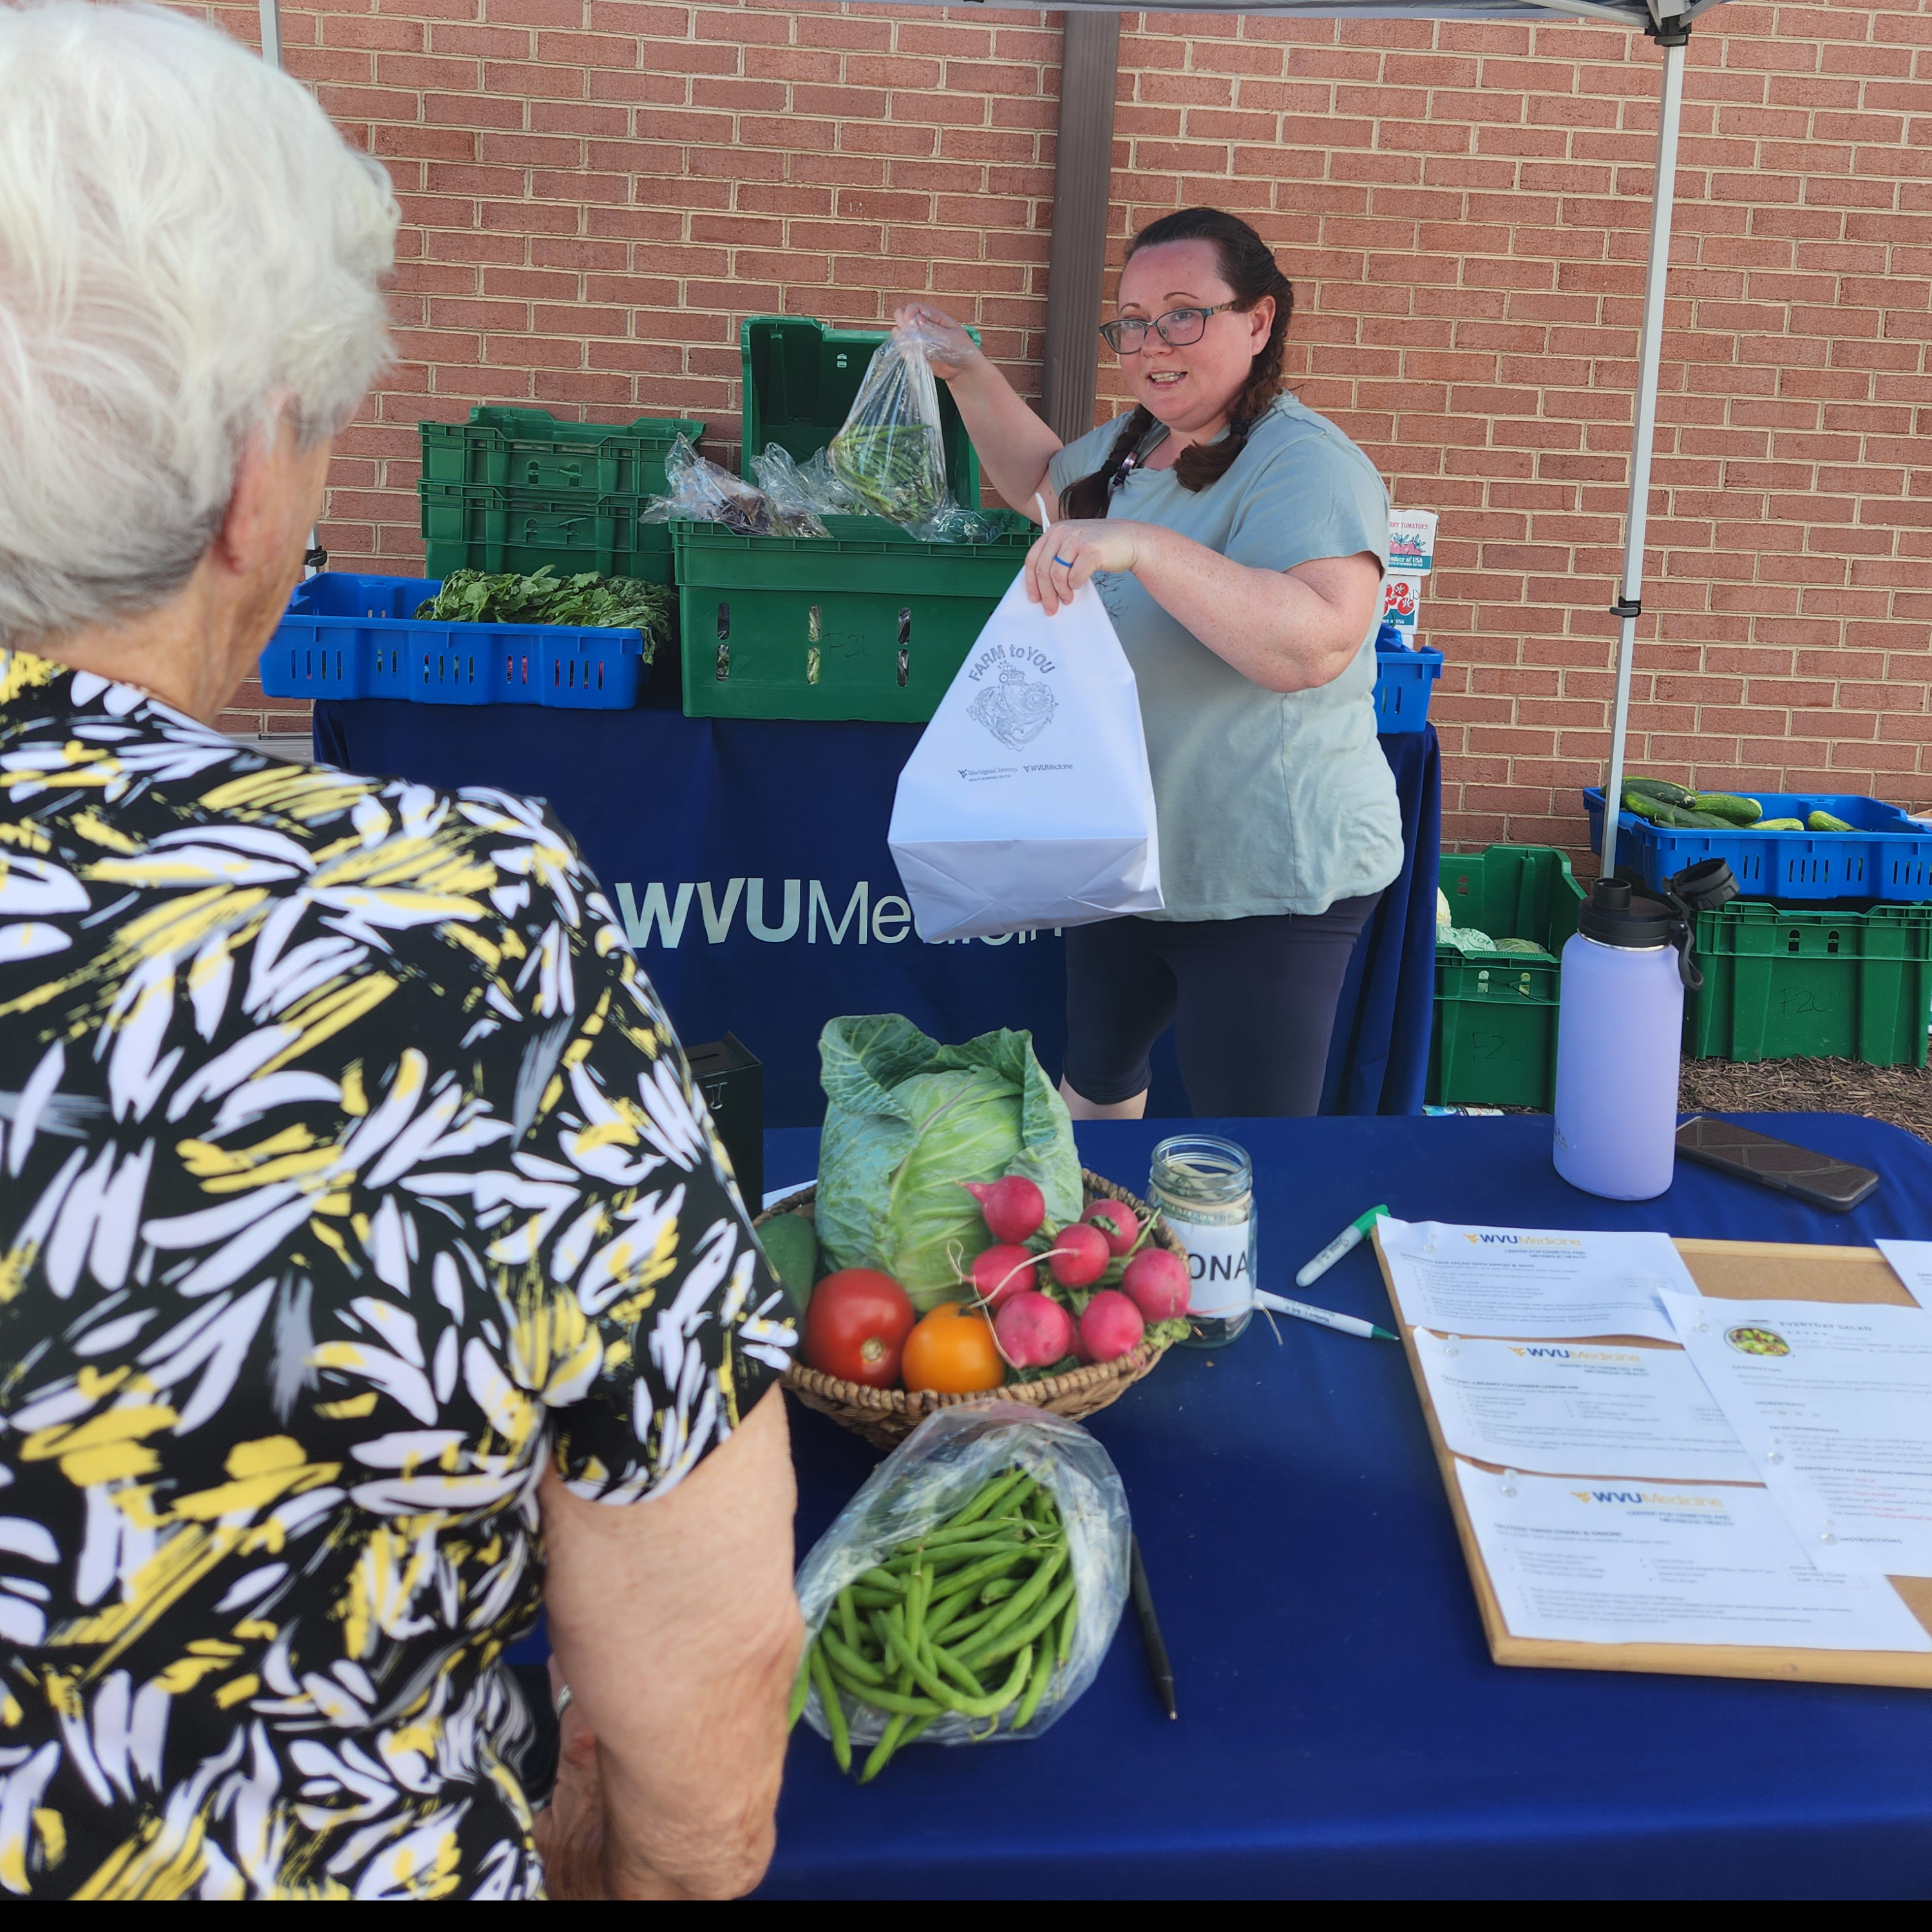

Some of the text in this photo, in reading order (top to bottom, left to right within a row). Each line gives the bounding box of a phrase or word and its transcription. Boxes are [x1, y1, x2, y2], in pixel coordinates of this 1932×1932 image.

[968, 644, 1056, 682] FARM to YOU
[1779, 987, 1831, 1013] F2U
[1592, 1491, 1724, 1508] WVUMedicine
